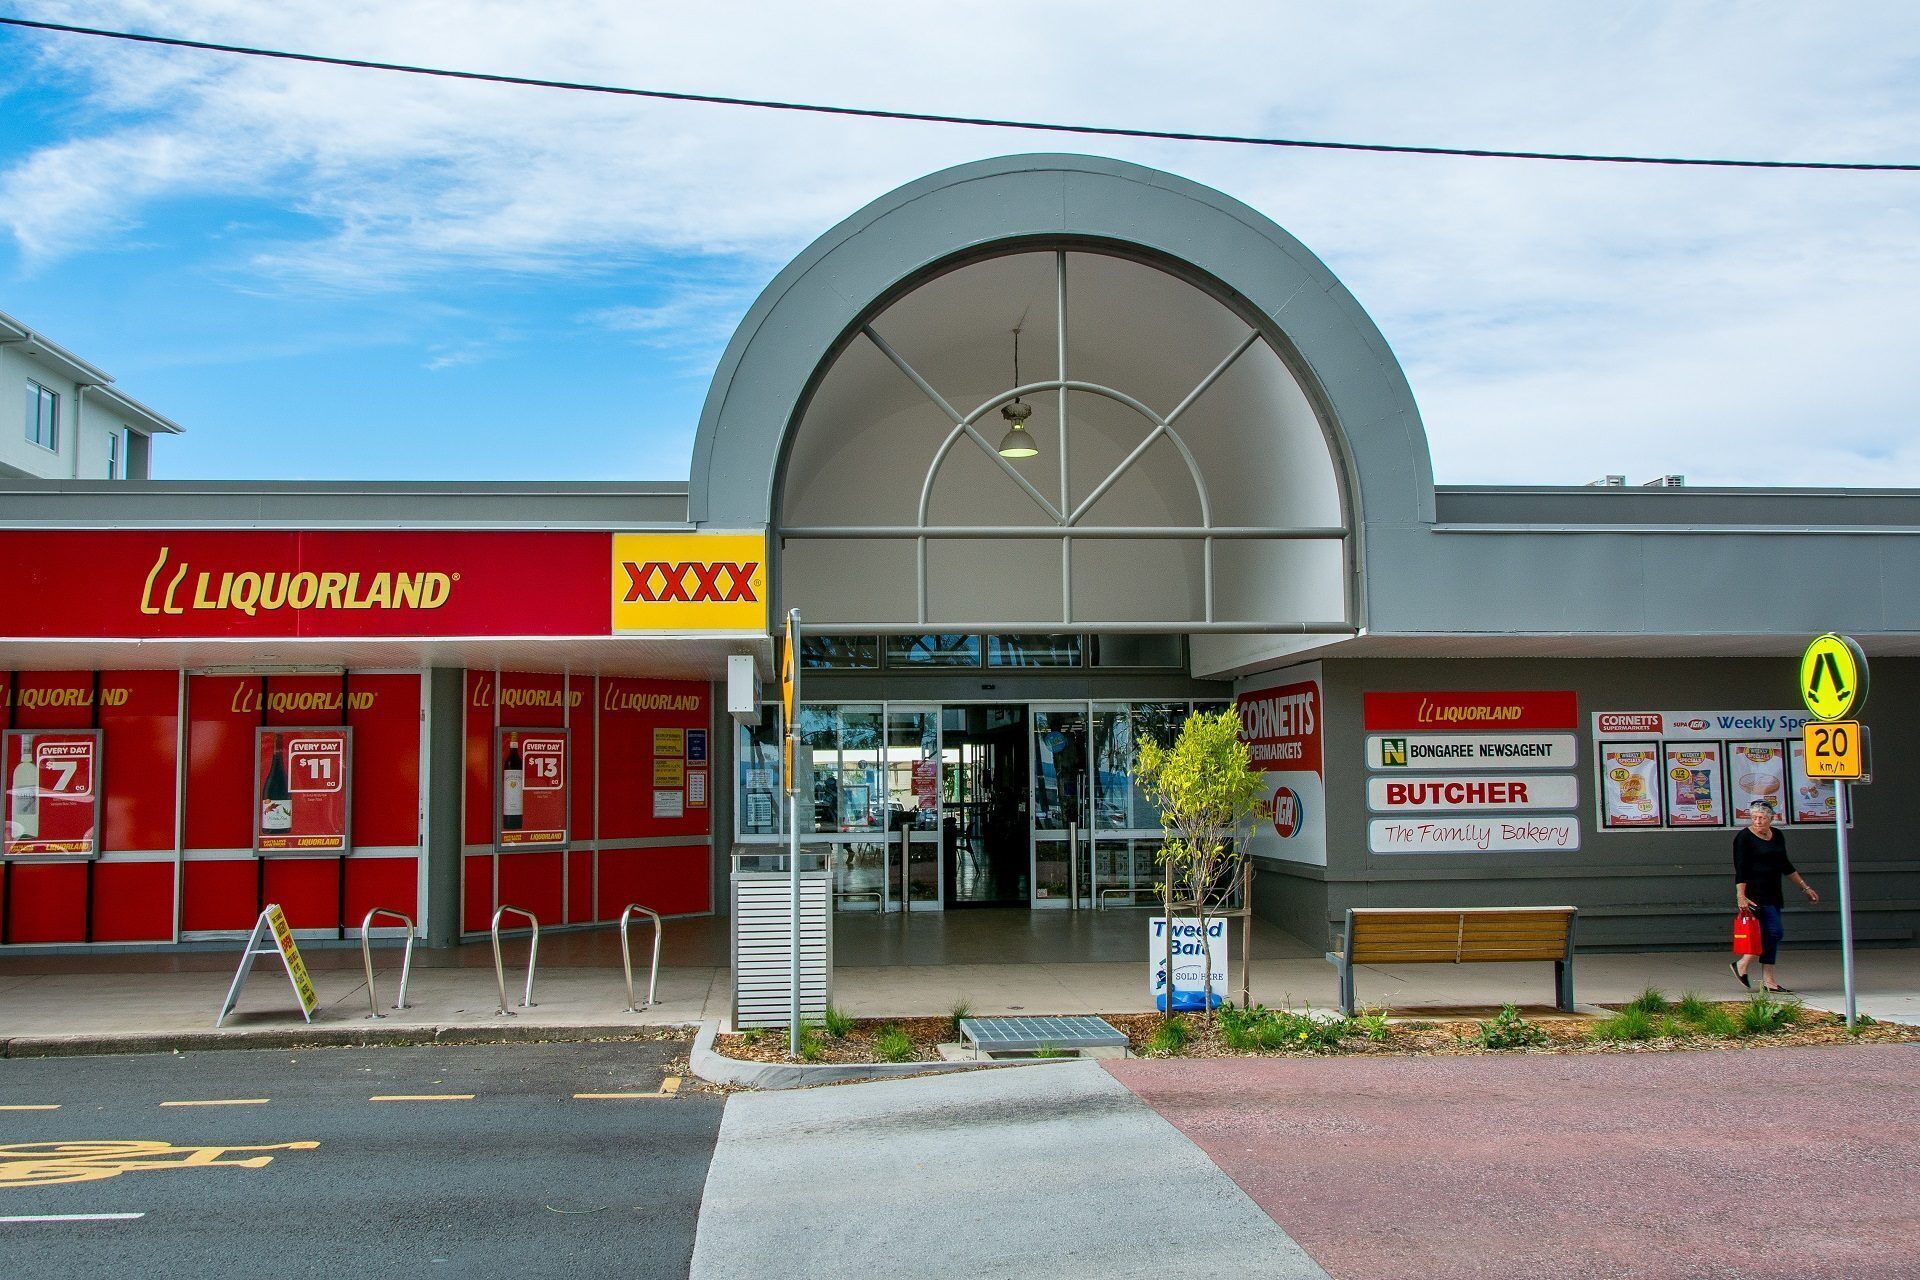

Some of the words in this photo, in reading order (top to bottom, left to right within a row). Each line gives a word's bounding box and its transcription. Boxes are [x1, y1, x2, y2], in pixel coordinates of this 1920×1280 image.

[622, 561, 759, 603] XXXX
[193, 571, 451, 616] LIQUORLAND
[621, 693, 700, 712] LIQUORLAND
[1240, 691, 1315, 740] CORNETTS
[1435, 706, 1522, 722] LIQUORLAND
[1601, 715, 1659, 726] CORNETTS
[1717, 716, 1775, 732] Weekly
[42, 747, 67, 755] EVERY
[294, 743, 320, 751] EVERY
[321, 743, 338, 751] DAY
[1248, 741, 1302, 760] PERMARKETS
[1410, 744, 1474, 758] BONGAREE
[1479, 743, 1553, 757] NEWSAGENT
[1814, 728, 1848, 757] 20
[1819, 762, 1845, 773] km/h
[1386, 782, 1528, 805] BUTCHER
[1275, 796, 1293, 825] IGA
[1385, 825, 1414, 843] The
[1417, 824, 1491, 850] Family
[1500, 822, 1569, 846] Bakery
[1175, 973, 1198, 981] SOLD
[1200, 973, 1224, 981] HRE
